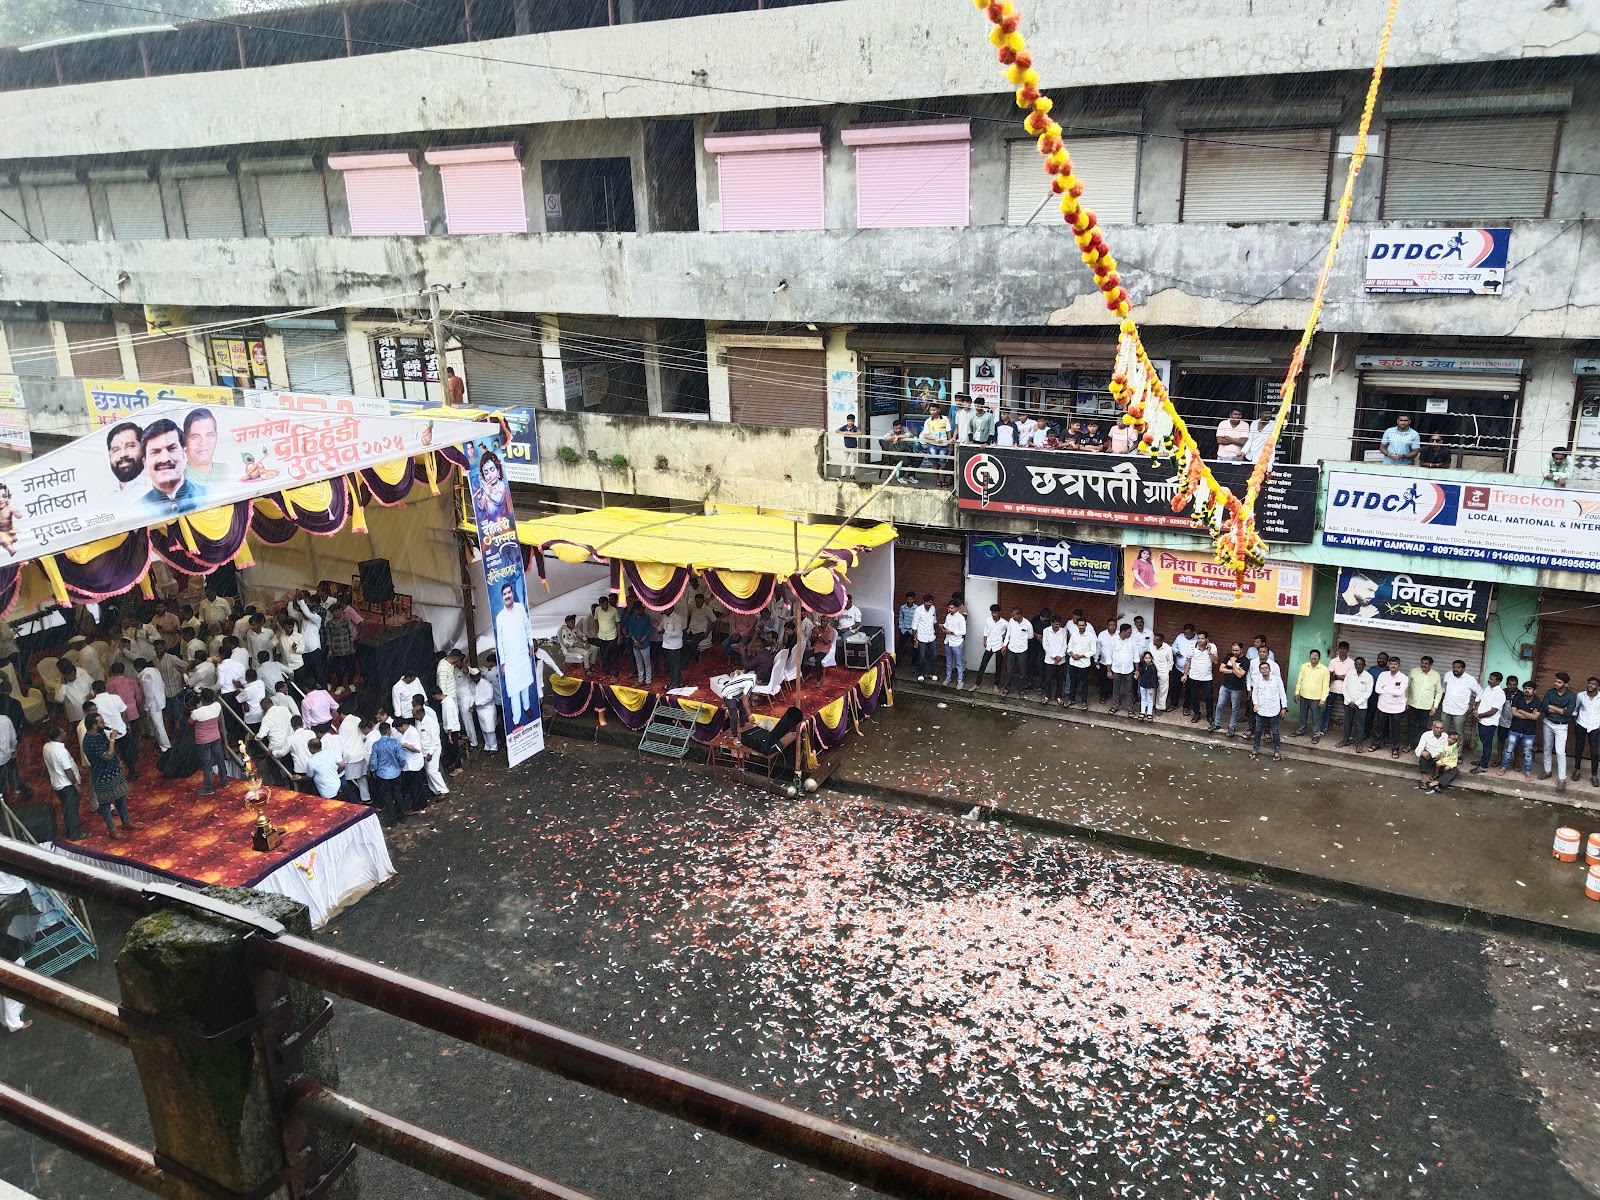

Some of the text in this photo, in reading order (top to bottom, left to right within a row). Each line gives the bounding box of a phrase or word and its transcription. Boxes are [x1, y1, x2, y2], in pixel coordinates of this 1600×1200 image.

[1370, 243, 1443, 260] DTDC
[1472, 360, 1517, 368] ENTERPRISES
[229, 417, 291, 443] जनसेवा
[272, 416, 362, 460] दहिहंडी
[277, 434, 405, 480] उत्सव २०२४
[21, 467, 76, 493] जनसेवा
[1025, 461, 1142, 506] छत्रपती
[25, 489, 88, 518] प्रतिष्ठान
[1333, 489, 1400, 512] DTDC
[1492, 489, 1566, 509] Trackon
[30, 513, 116, 546] मुरबाड आयोजित
[1468, 512, 1502, 524] LOCAL,
[1505, 516, 1556, 528] NATIONAL
[1559, 521, 1567, 529] &
[1326, 534, 1339, 544] Mr.
[1341, 536, 1382, 548] JAYWANT
[1384, 540, 1426, 553] GAIKWAD
[1432, 545, 1486, 559] 8097962754
[1484, 540, 1506, 549] Behind
[1507, 543, 1535, 552] Congress
[1535, 545, 1559, 554] Bhavan,
[1560, 548, 1584, 556] Murbad
[1069, 556, 1112, 571] कलेक्शन
[1158, 551, 1198, 573] निशा
[1201, 575, 1218, 587] अंडर
[1219, 579, 1251, 591] गारमेस
[1391, 573, 1477, 609] निहाल
[1444, 608, 1478, 624] पार्लर
